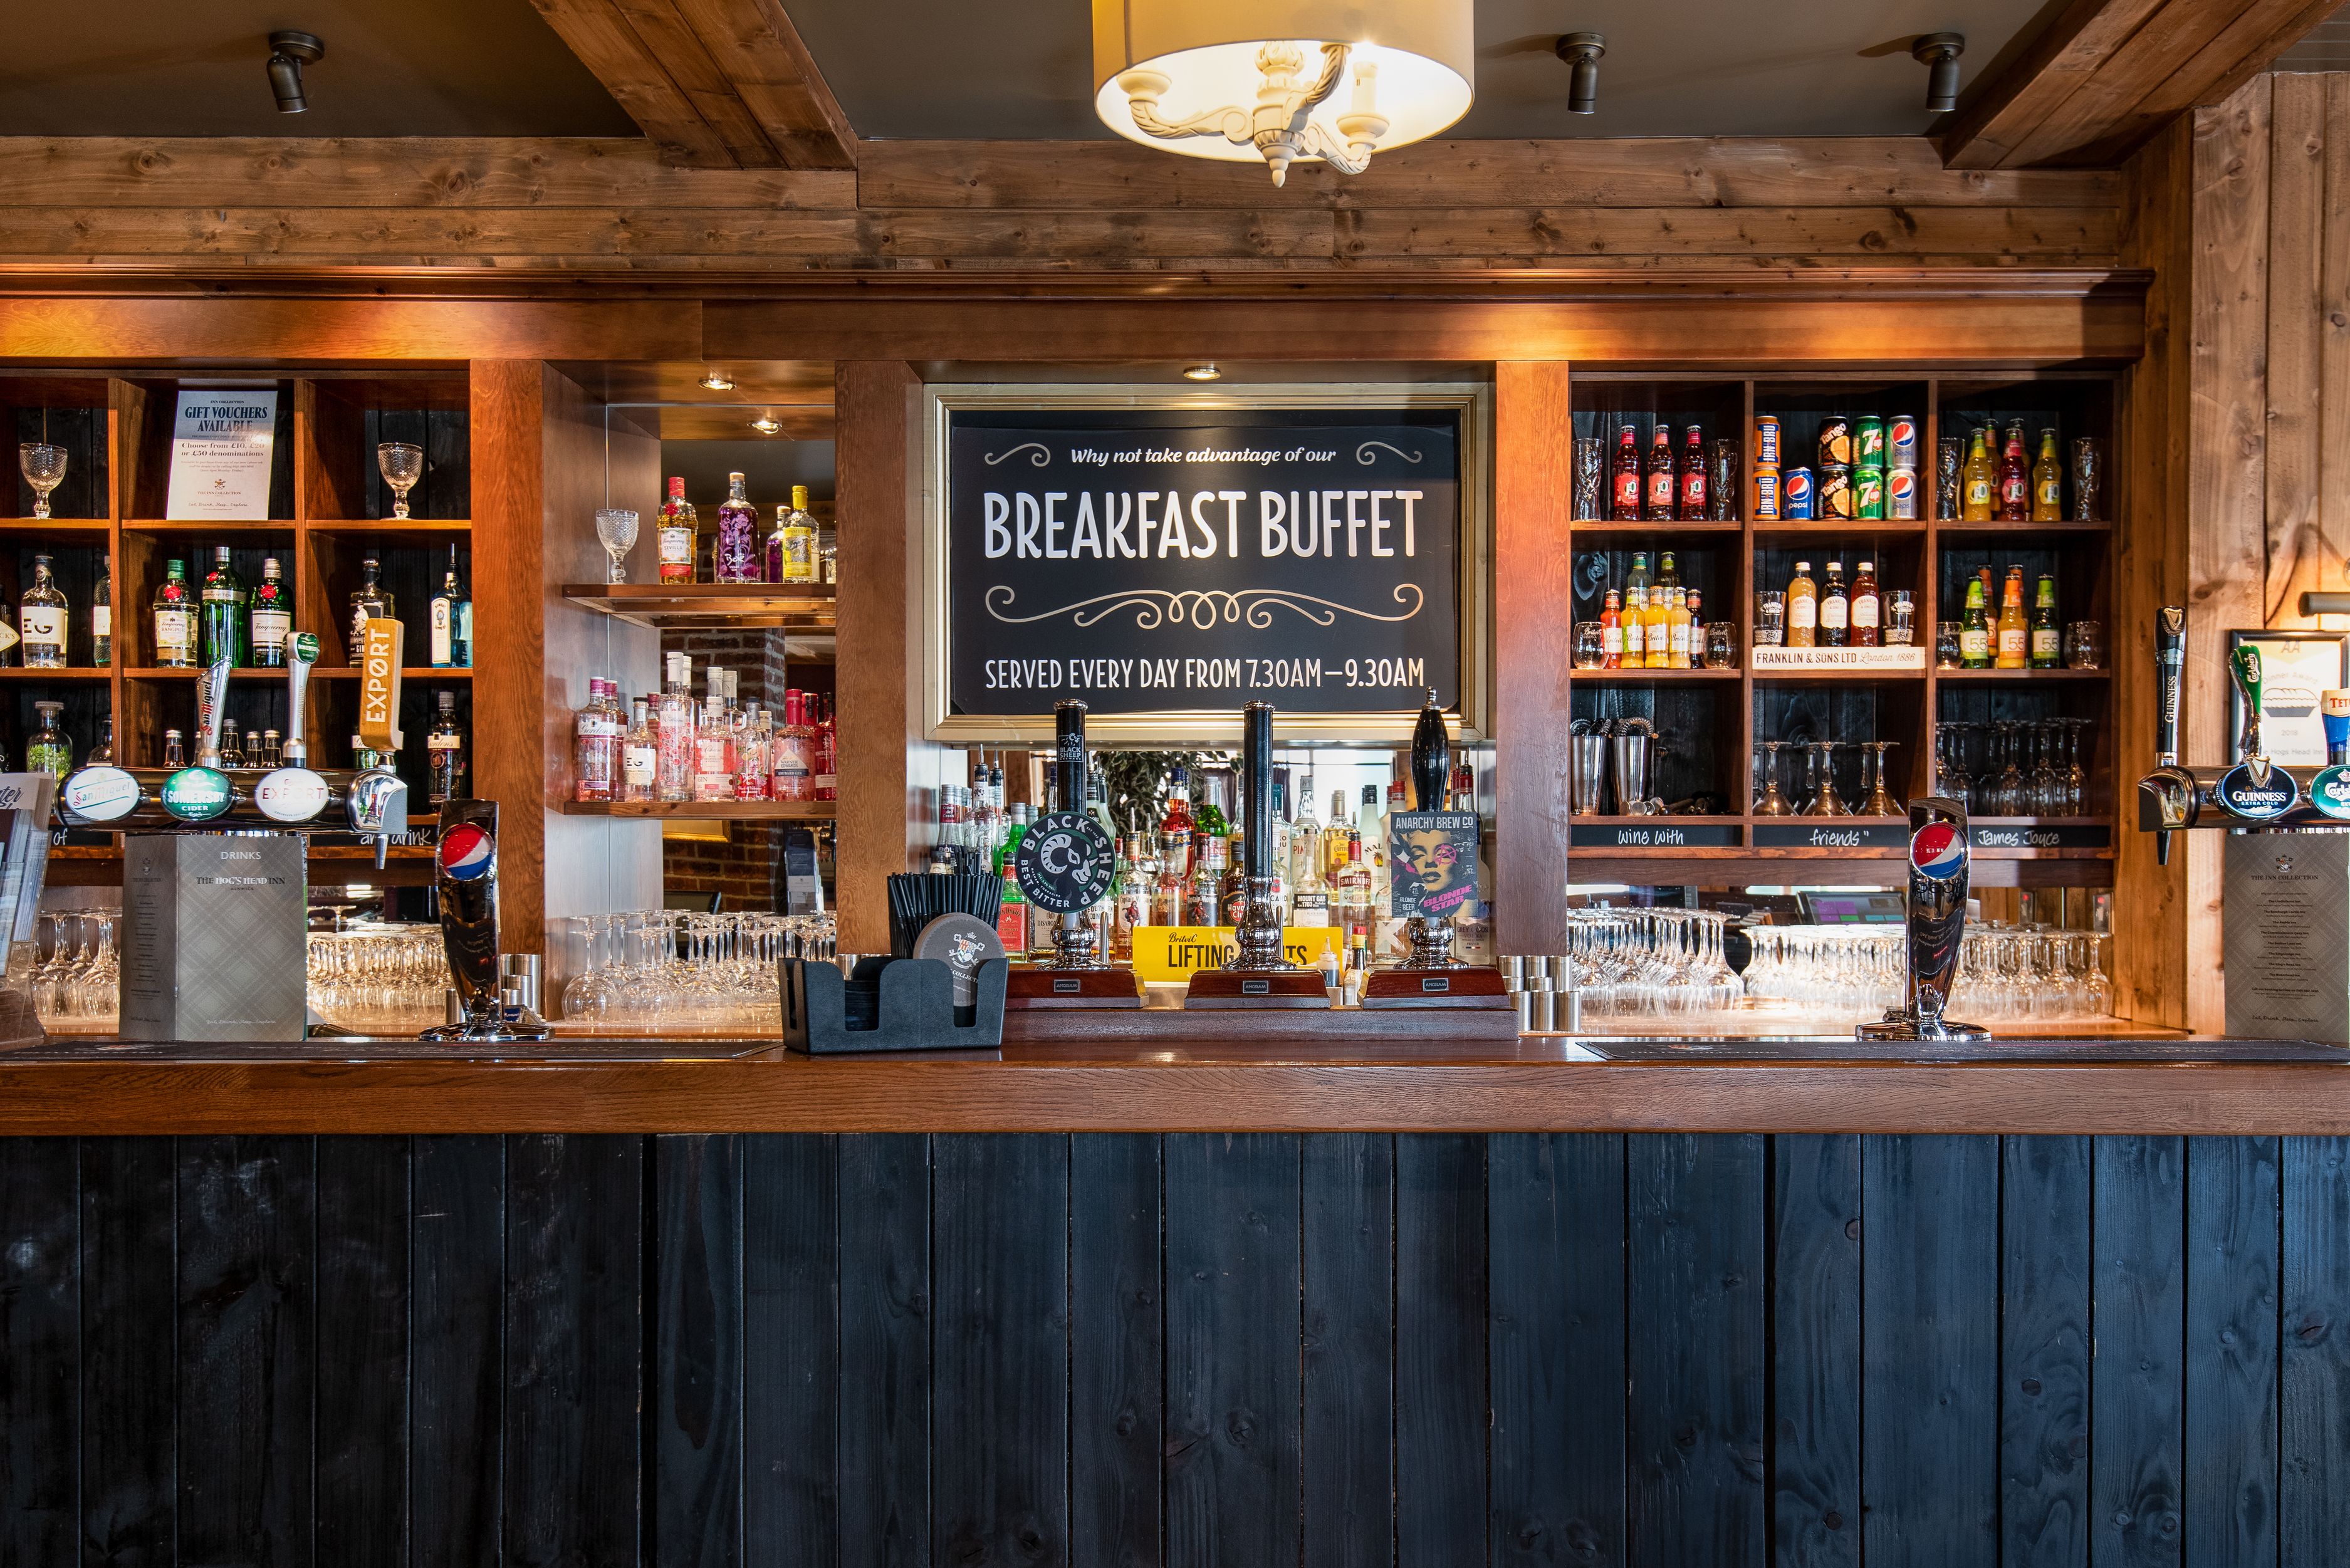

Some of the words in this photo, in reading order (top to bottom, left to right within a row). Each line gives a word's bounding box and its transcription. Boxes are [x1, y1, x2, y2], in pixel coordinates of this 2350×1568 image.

[185, 407, 210, 418] GIFT
[212, 407, 268, 419] VOUCHERS
[197, 420, 253, 432] AVAILABLE
[1820, 423, 1846, 445] Tango
[1071, 448, 1109, 466] Why
[1114, 448, 1141, 463] not
[1146, 447, 1181, 463] take
[1186, 447, 1280, 465] advantage
[1285, 447, 1304, 462] of
[1305, 450, 1336, 462] our
[1820, 476, 1847, 496] Tango
[984, 491, 1246, 558] BREAKFAST
[1260, 491, 1423, 557] BUFFET
[255, 623, 287, 632] Tanqueray
[1970, 638, 1987, 651] 55
[2008, 637, 2024, 651] 55
[2042, 637, 2059, 651] 55
[1757, 653, 1803, 664] FRANKLIN
[1806, 653, 1813, 663] &
[1815, 653, 1839, 663] SONS
[1841, 653, 1857, 663] LTD
[1859, 652, 1893, 663] London
[1896, 652, 1915, 662] 1886
[985, 659, 1062, 688] SERVED
[1070, 659, 1134, 688] EVERY
[1140, 659, 1179, 687] DAY
[1185, 659, 1240, 687] FROM
[2165, 675, 2176, 724] GUINNESS
[167, 791, 225, 803] SOMERSBY
[2232, 792, 2286, 802] GUINNESS
[1396, 817, 1433, 828] ANARCHY
[1436, 817, 1460, 828] BREW
[1463, 817, 1473, 828] CO
[1618, 829, 1649, 845] wine
[1655, 828, 1684, 845] with
[1978, 830, 2019, 846] James
[2023, 830, 2060, 847] Joyce
[220, 851, 261, 860] DRINKS
[1021, 815, 1090, 851] BLACK
[1080, 837, 1112, 905] SHEEP
[1021, 860, 1034, 886] BEST
[1032, 888, 1070, 907] BITTER
[1340, 877, 1371, 886] SMIRNOFF
[1423, 884, 1472, 907] BLONDE
[1431, 896, 1465, 912] STAR
[1168, 945, 1235, 968] LIFTING
